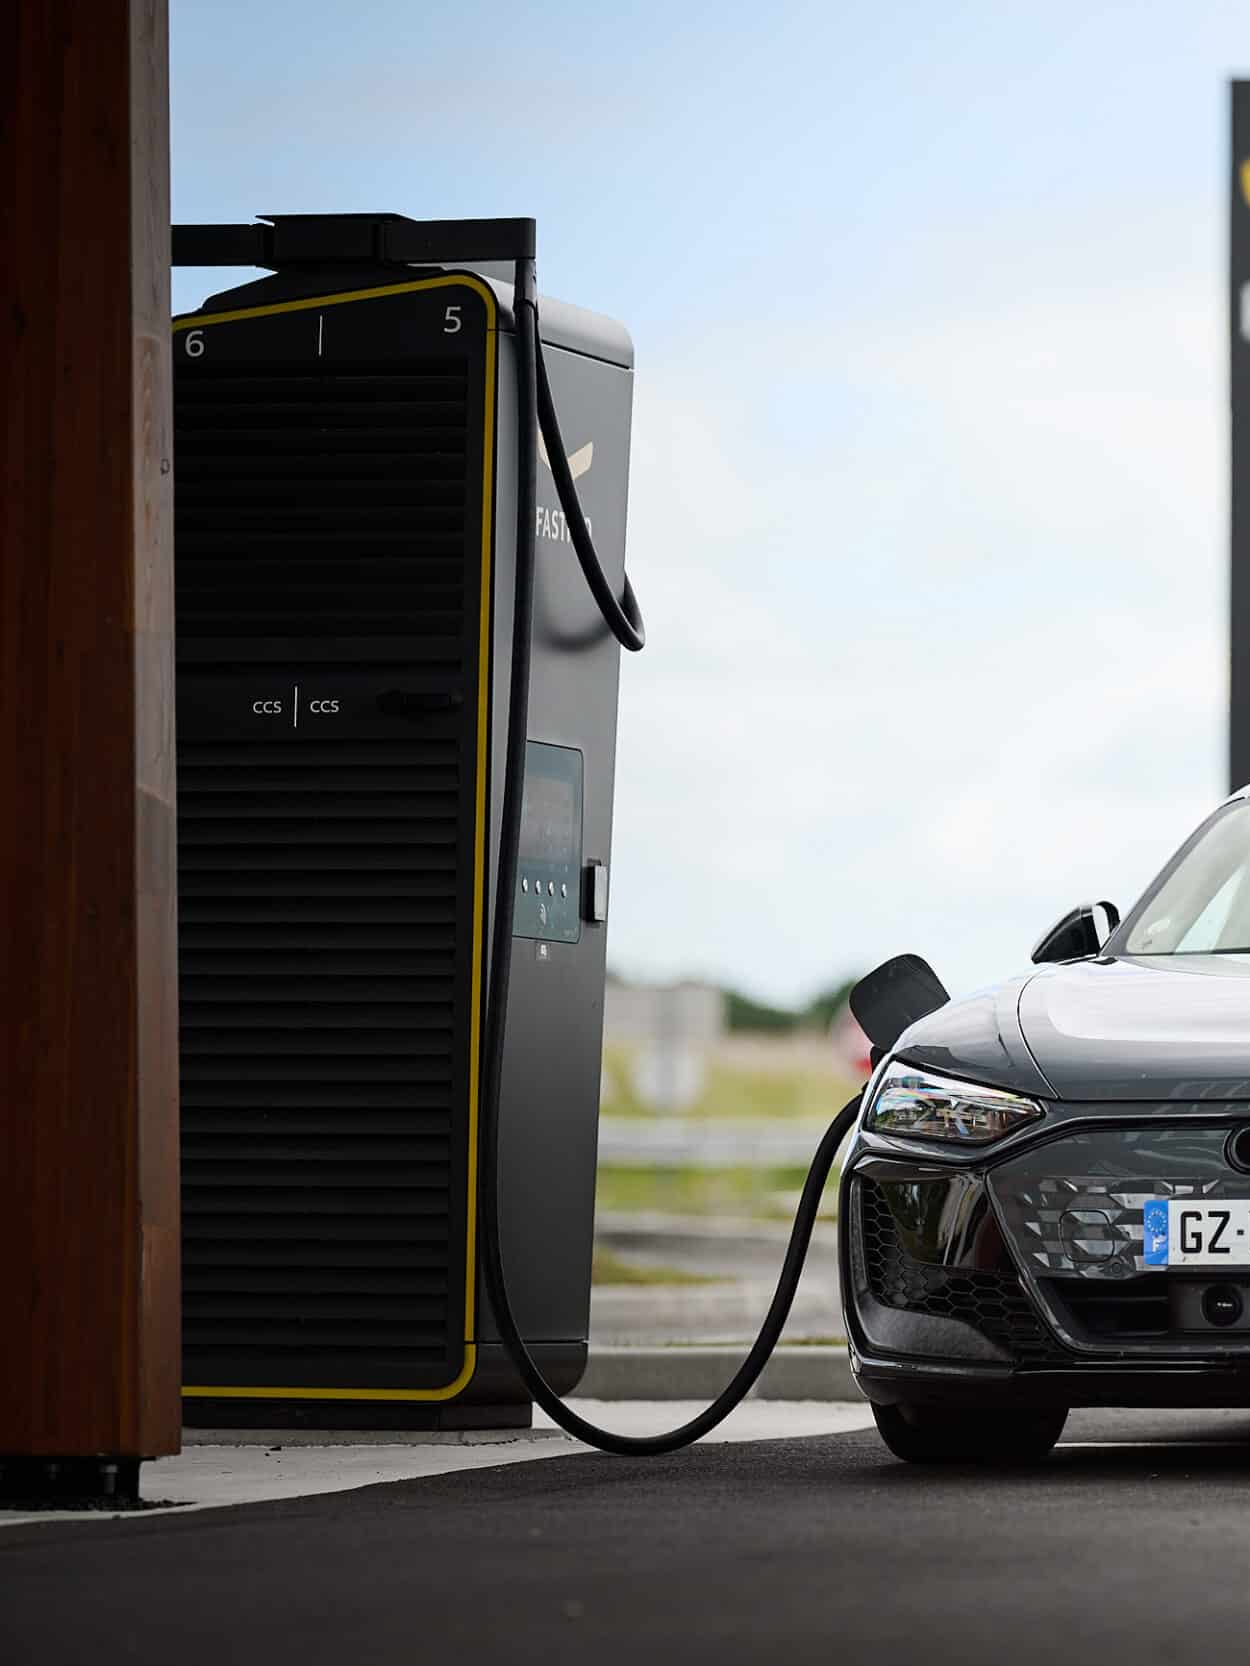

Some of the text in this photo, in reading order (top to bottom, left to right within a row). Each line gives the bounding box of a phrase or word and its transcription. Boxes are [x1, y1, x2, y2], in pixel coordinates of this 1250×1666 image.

[443, 306, 462, 333] 5
[184, 330, 205, 357] 6
[536, 506, 592, 544] FAST
[252, 700, 340, 714] CCS CCS
